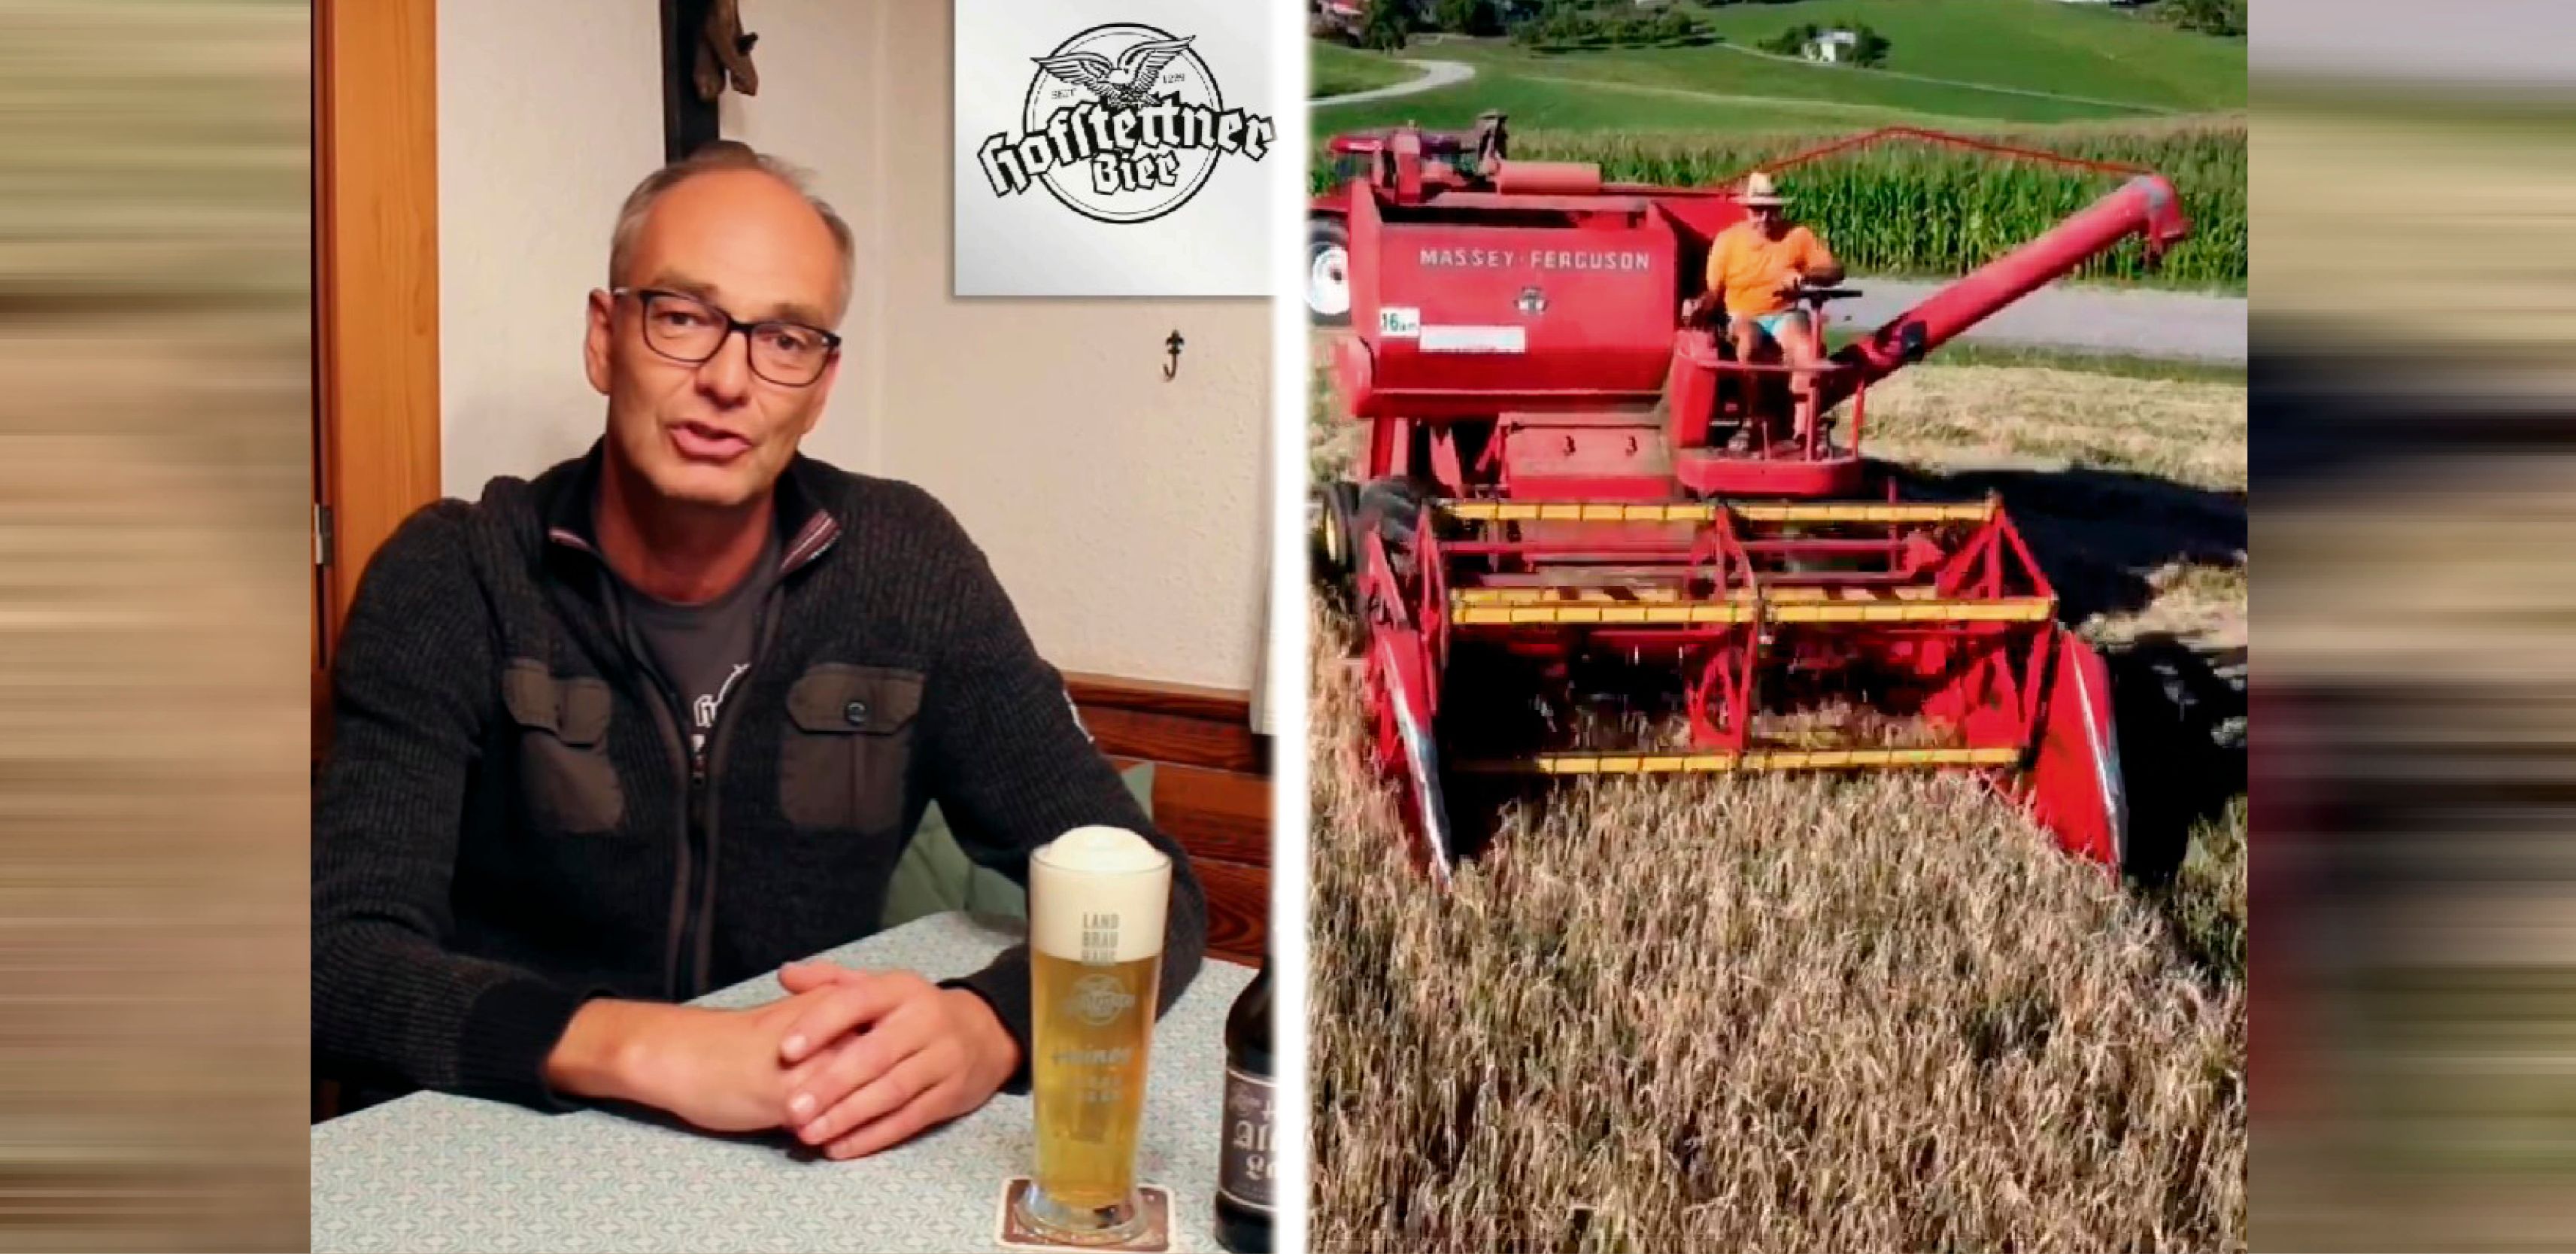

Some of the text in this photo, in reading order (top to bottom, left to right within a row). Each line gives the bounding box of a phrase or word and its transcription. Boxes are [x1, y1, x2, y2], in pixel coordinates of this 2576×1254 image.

[1419, 247, 1650, 270] MASSEY FERGUSON
[1082, 911, 1120, 929] LAND
[1082, 931, 1119, 948] BRAU
